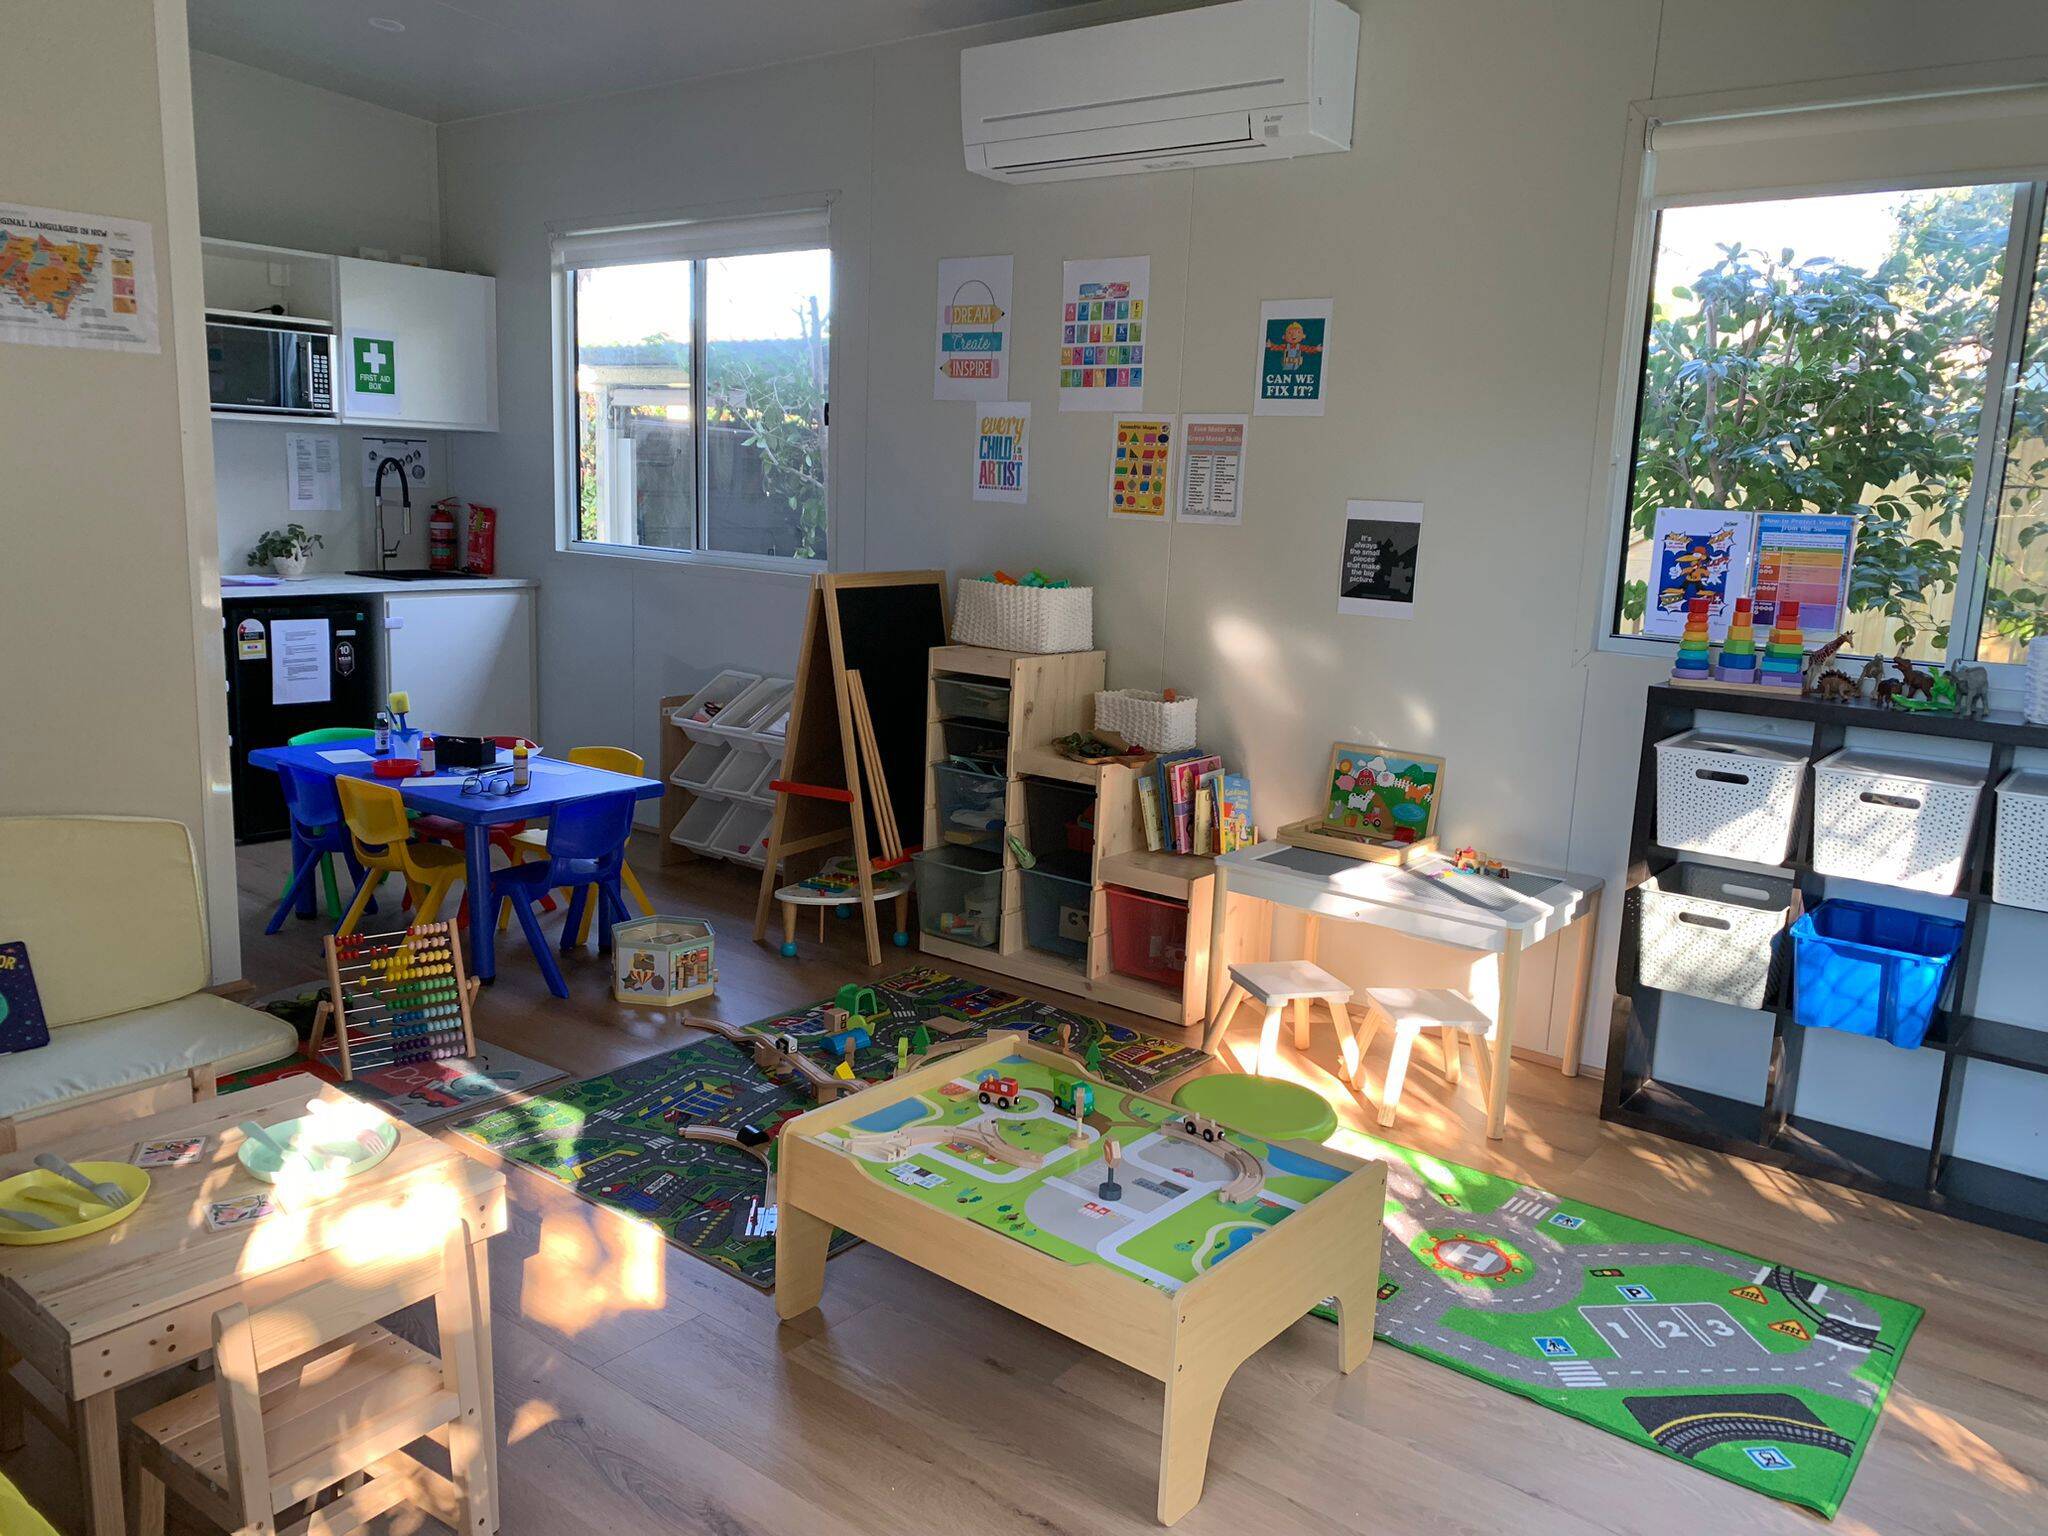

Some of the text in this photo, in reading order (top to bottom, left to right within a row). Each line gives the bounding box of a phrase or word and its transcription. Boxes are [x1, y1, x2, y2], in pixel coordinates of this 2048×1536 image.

[29, 220, 78, 234] LANGUAGES
[953, 306, 991, 323] DREAM
[952, 334, 990, 351] Create
[952, 361, 989, 376] INSPIRE
[360, 373, 391, 383] FIRST AID
[1266, 374, 1315, 384] CAN WE
[368, 382, 381, 390] BOX
[1266, 385, 1314, 397] FIX IT?
[981, 415, 1025, 445] every
[980, 435, 1013, 460] CHILD
[980, 460, 1023, 487] ARTIST
[1354, 542, 1378, 550] always
[1350, 576, 1375, 584] picture.
[340, 645, 350, 655] 10
[587, 1157, 622, 1172] BUS
[1447, 1243, 1498, 1271] H
[1628, 1288, 1642, 1297] P
[1606, 1319, 1735, 1339] 1 2 3
